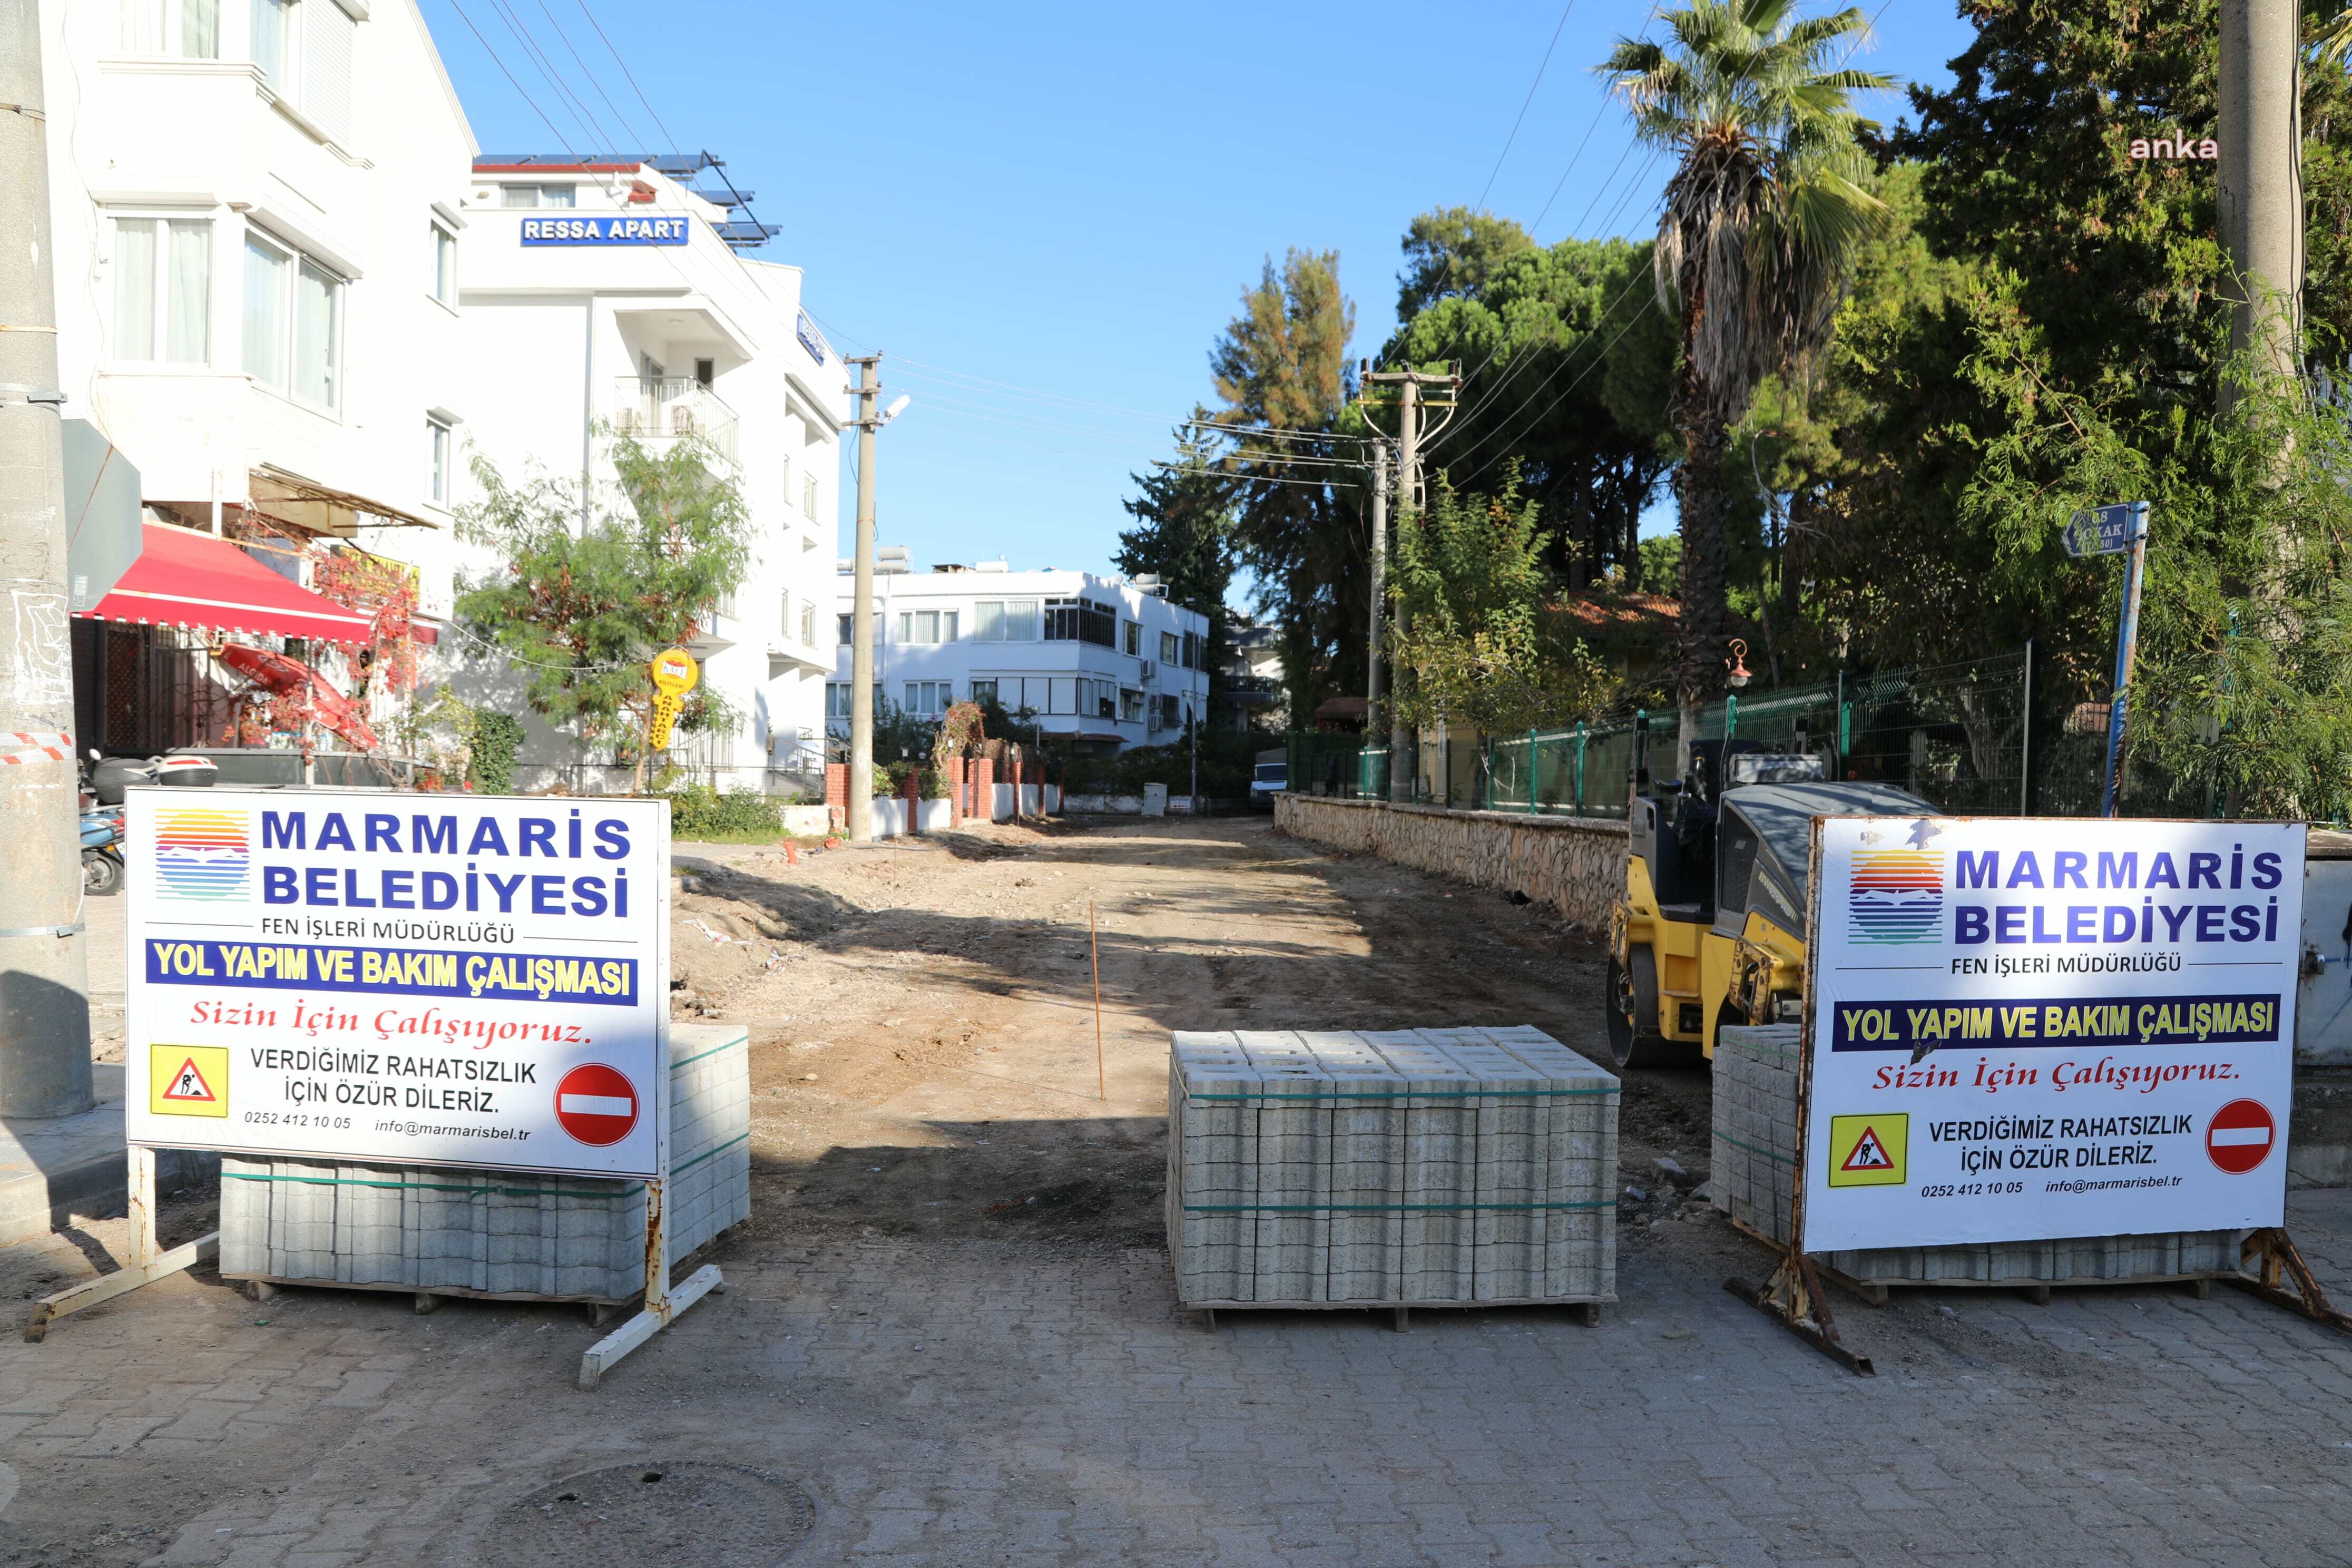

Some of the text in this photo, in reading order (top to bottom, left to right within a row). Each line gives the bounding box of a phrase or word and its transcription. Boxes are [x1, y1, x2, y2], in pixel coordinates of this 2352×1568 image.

[524, 220, 684, 239] RESSA APART
[2077, 524, 2122, 541] OKAK
[262, 809, 630, 859] MARMARİS
[1956, 843, 2282, 890] MARMARİS
[264, 863, 627, 917] BELEDİYESİ
[262, 916, 514, 943] FEN İŞLERİ MÜDÜRLÜĞÜ
[1954, 895, 2278, 945] BELEDİYESİ
[154, 943, 629, 999] YOL YAPIM VE BAKIM ÇALIŞMASI
[1952, 952, 2181, 978] FEN İŞLERİ MÜDÜRLÜĞÜ
[190, 998, 591, 1050] Sizin İçin Çalışıyoruz.
[1843, 1003, 2273, 1042] YOL YAPIM VE BAKIM ÇALIŞMASI
[251, 1046, 536, 1084] VERDİĞİMİZ RAHATSIZLIK
[1873, 1056, 2240, 1093] Sizin İçin Çalışıyoruz.
[285, 1076, 498, 1113] İÇİN ÖZÜR DİLERİZ.
[244, 1111, 350, 1129] 0252 412 10 05
[375, 1118, 532, 1141] info@marmarisbel.tr
[1929, 1114, 2192, 1142] VERDİĞİMİZ RAHATSIZLIK
[1961, 1140, 2157, 1174] İÇİN ÖZÜR DİLERİZ.
[1922, 1182, 2023, 1198] 0252 412 10 05
[2045, 1175, 2182, 1193] info@marmarisbel.tr
